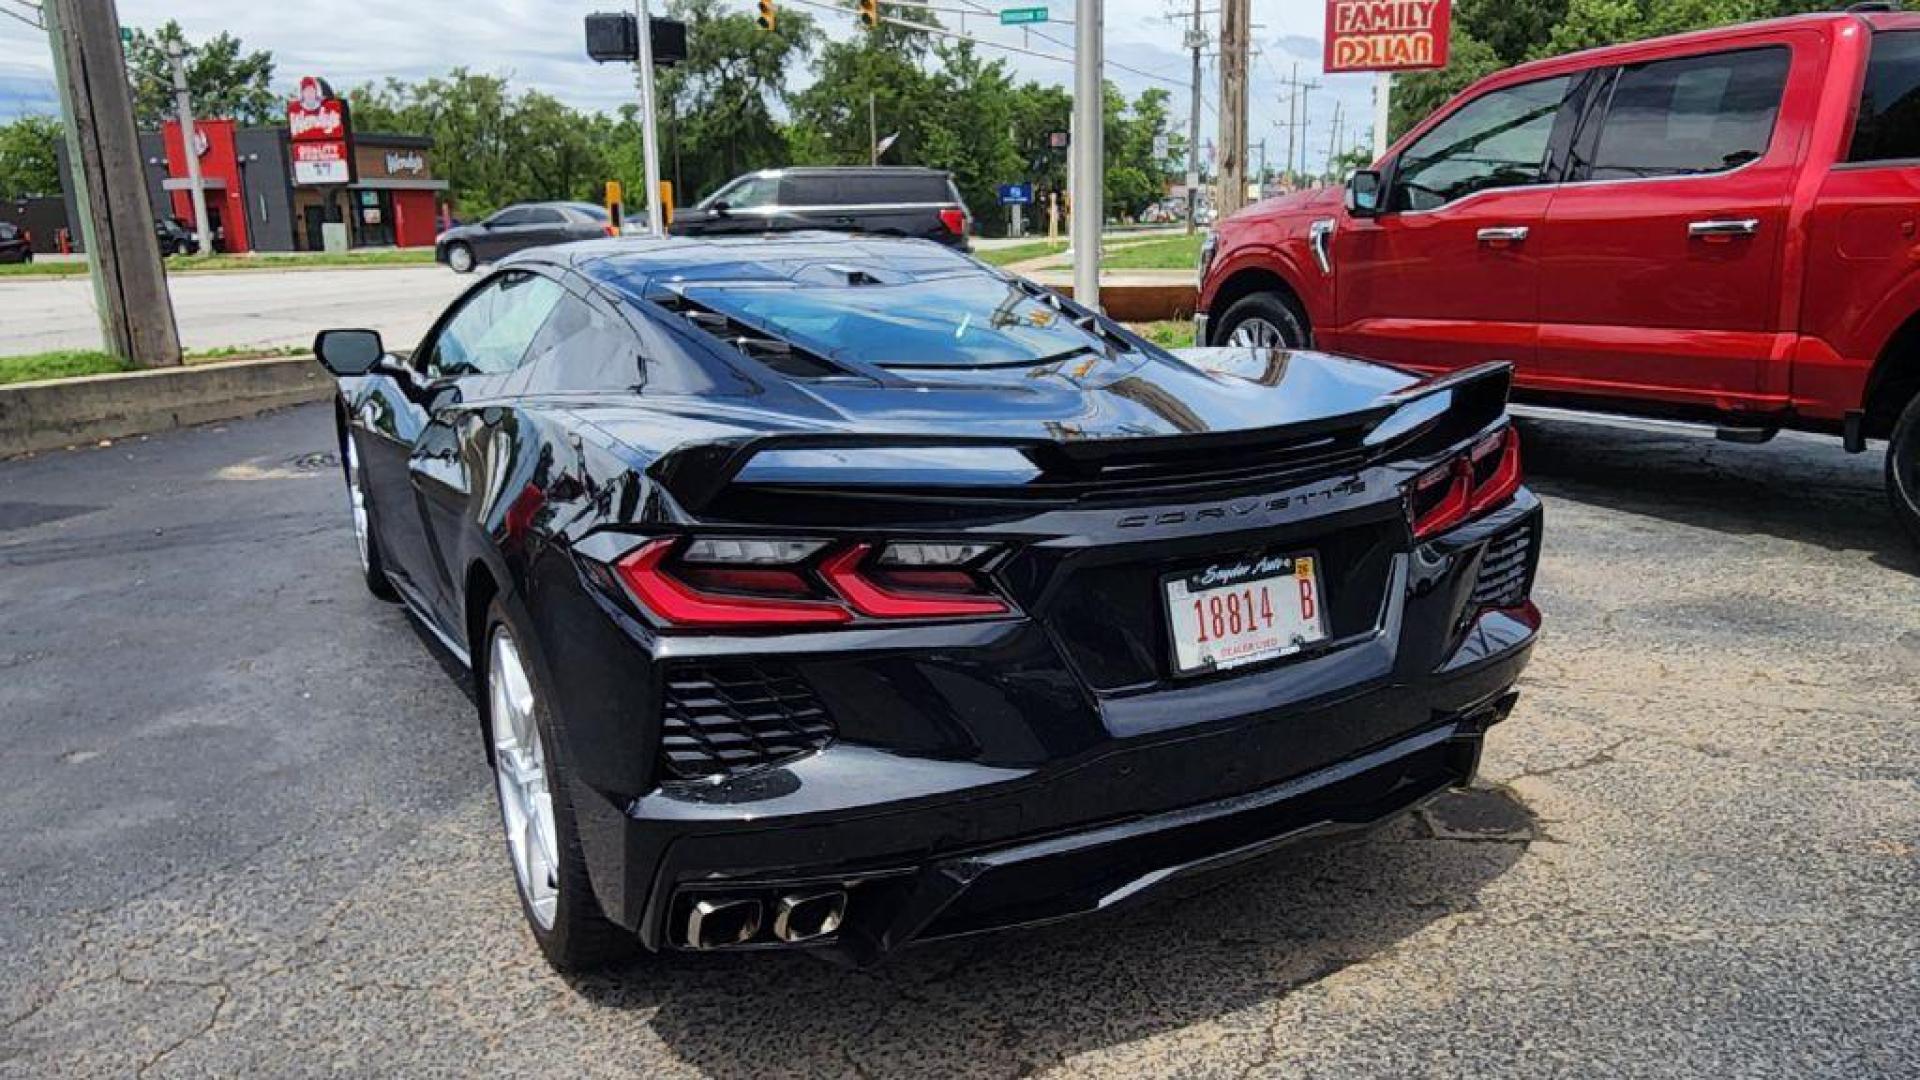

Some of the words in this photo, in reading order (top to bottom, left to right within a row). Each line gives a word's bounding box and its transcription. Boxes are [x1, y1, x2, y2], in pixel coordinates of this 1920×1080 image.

[1335, 1, 1436, 32] FAMILY
[1117, 476, 1366, 529] CORVETTE
[1194, 587, 1274, 642] 18814
[1299, 579, 1314, 619] B
